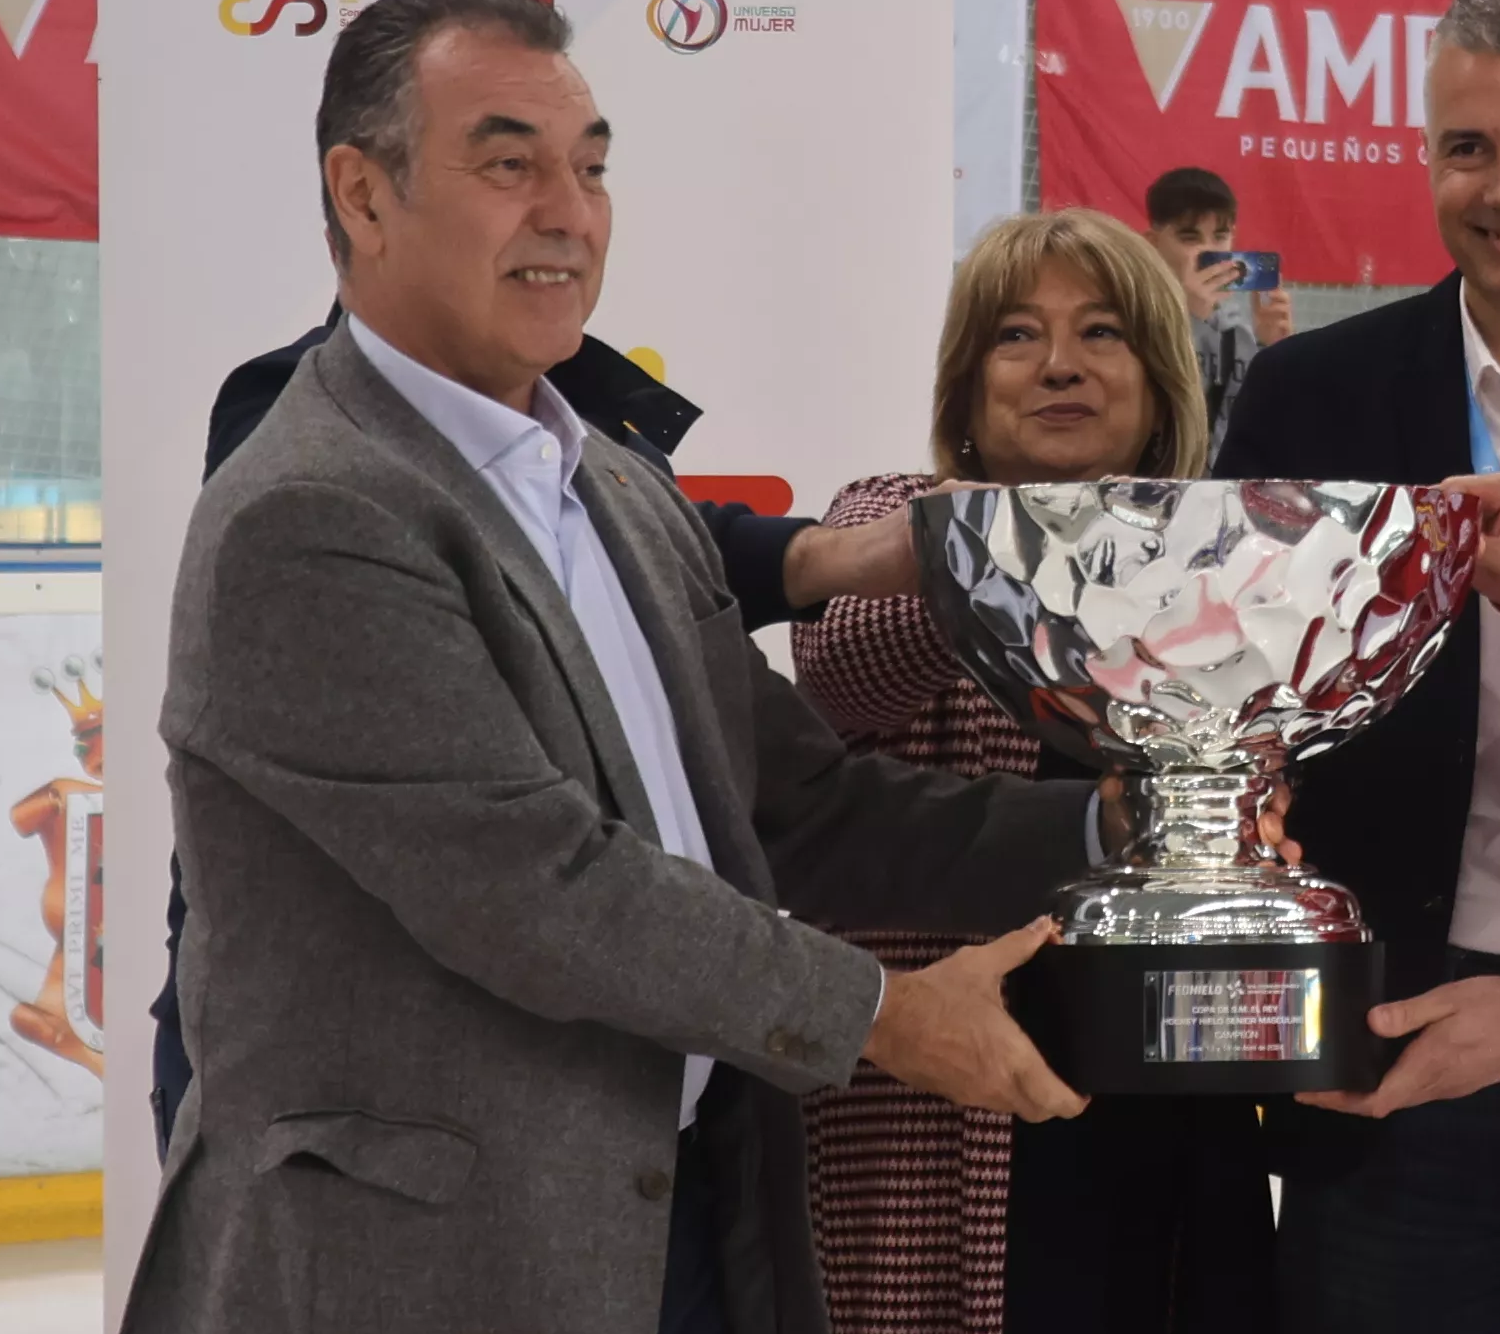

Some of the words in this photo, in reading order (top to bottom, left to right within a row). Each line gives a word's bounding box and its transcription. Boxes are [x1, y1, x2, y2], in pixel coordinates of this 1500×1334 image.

[734, 7, 796, 17] UNIVERSO
[1131, 8, 1190, 29] 1900
[734, 18, 795, 32] MUJER
[1240, 134, 1401, 164] PEQUEÑOS
[1168, 984, 1223, 996] FEDHIELO
